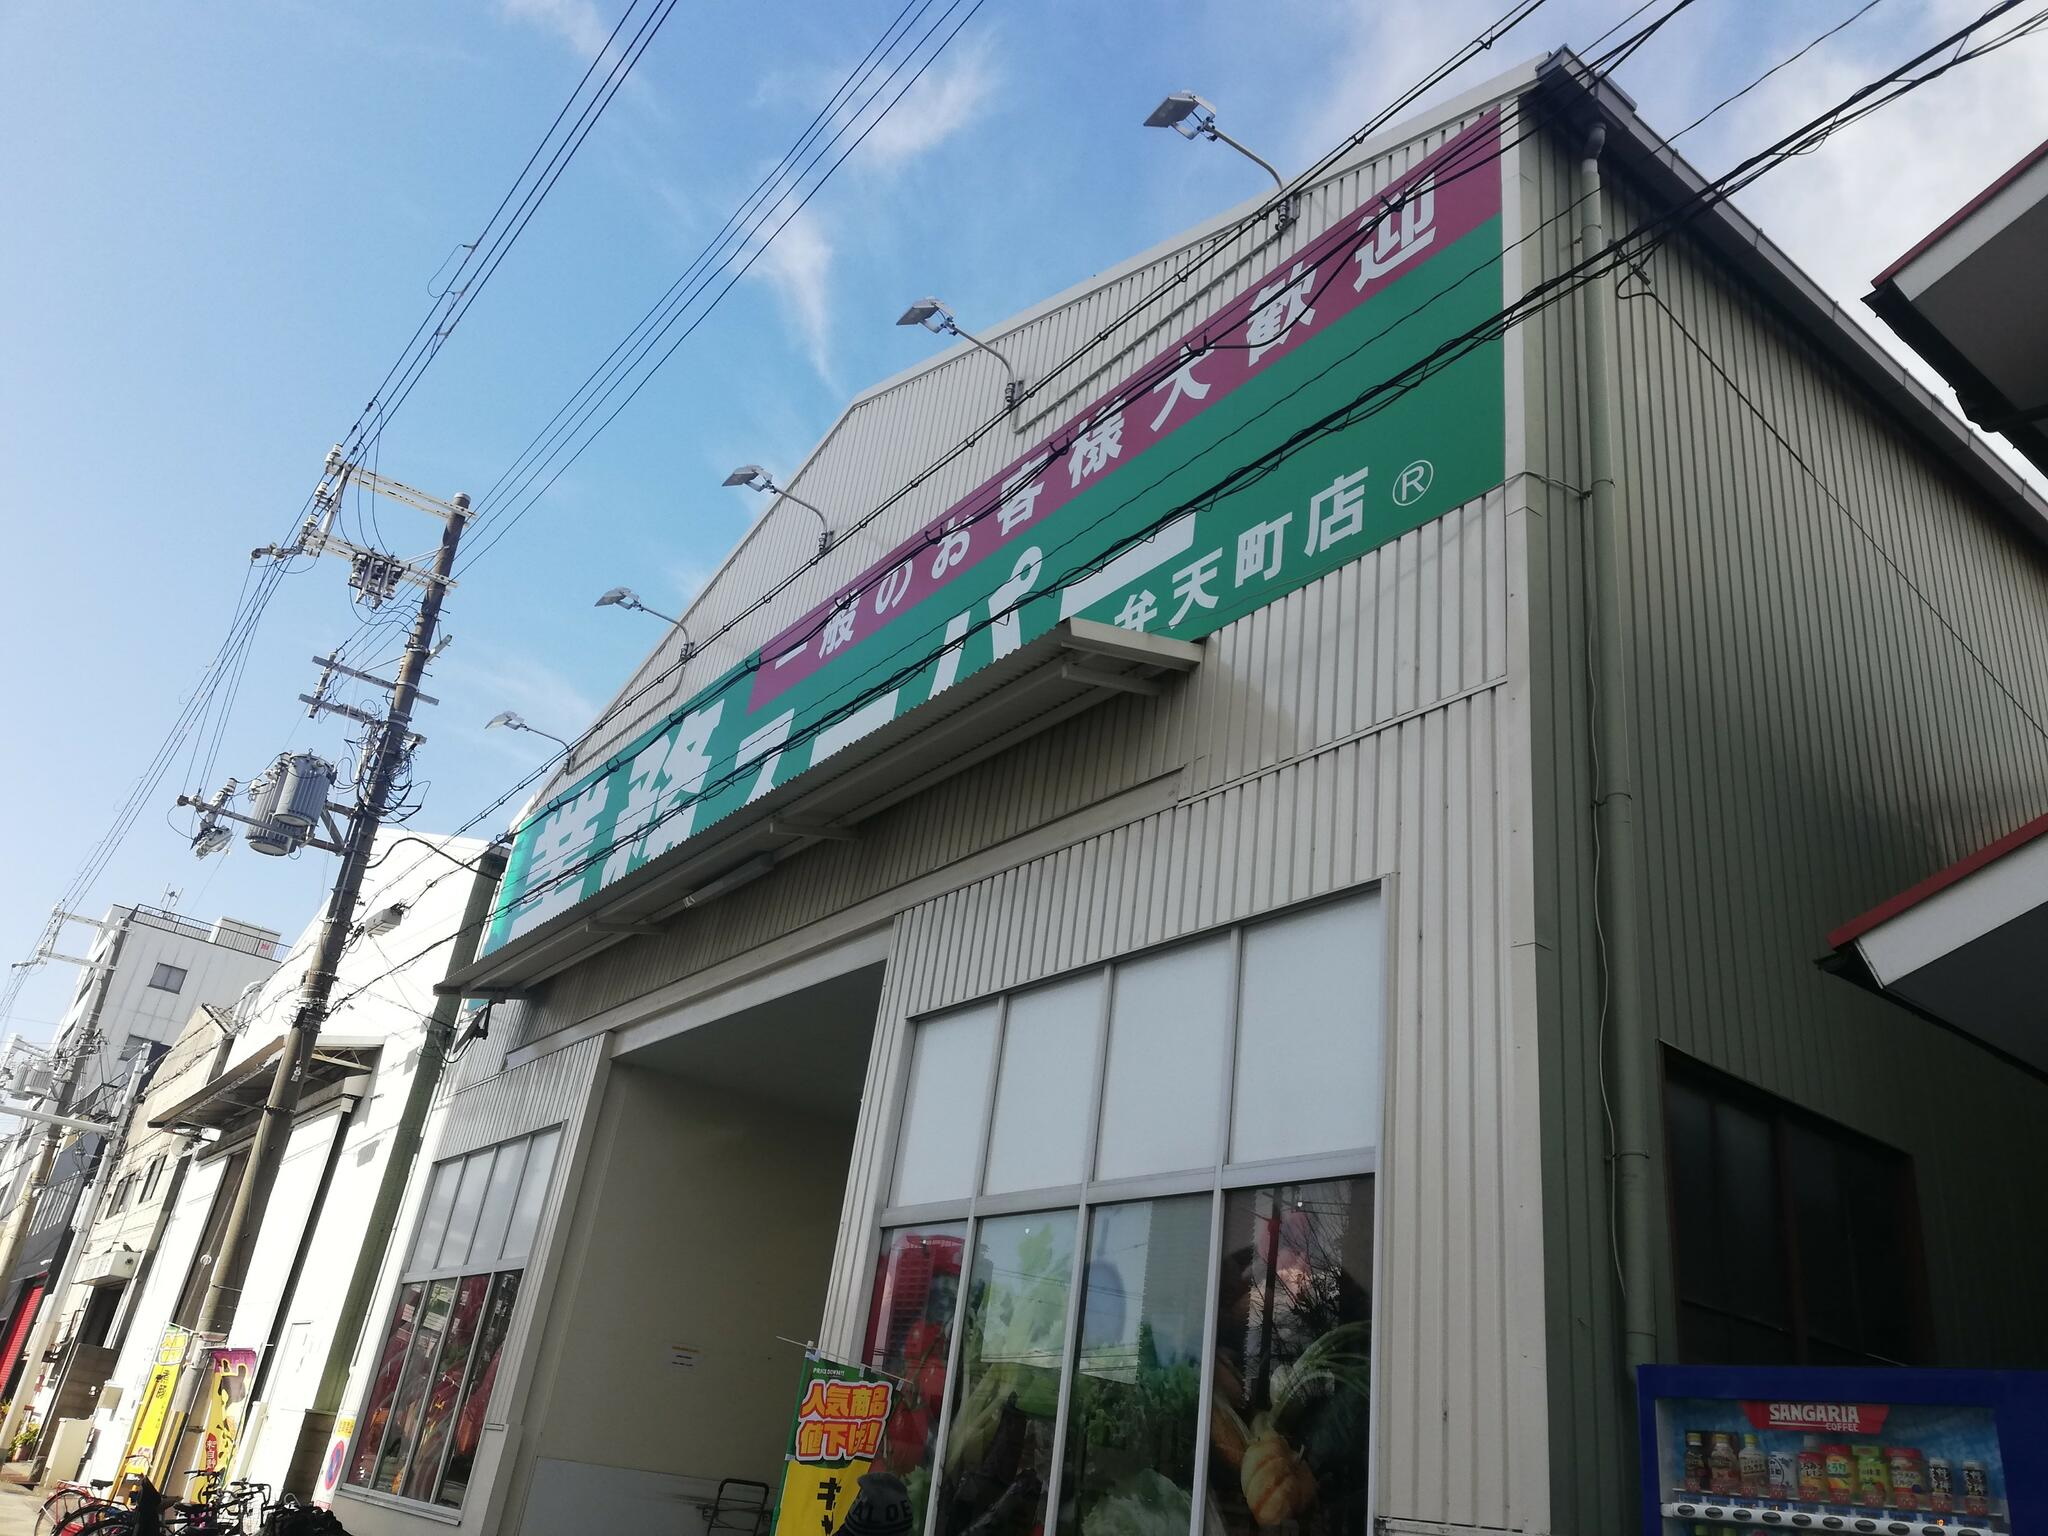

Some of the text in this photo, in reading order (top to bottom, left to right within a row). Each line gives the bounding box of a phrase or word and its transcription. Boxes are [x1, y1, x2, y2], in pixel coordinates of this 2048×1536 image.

[774, 170, 1437, 670] 一般のお客様大歓迎
[1114, 467, 1369, 630] 弁天町店
[800, 1383, 890, 1420] 人気商品
[1769, 1403, 1860, 1424] SANGARIA
[1825, 1422, 1859, 1433] COFFEE
